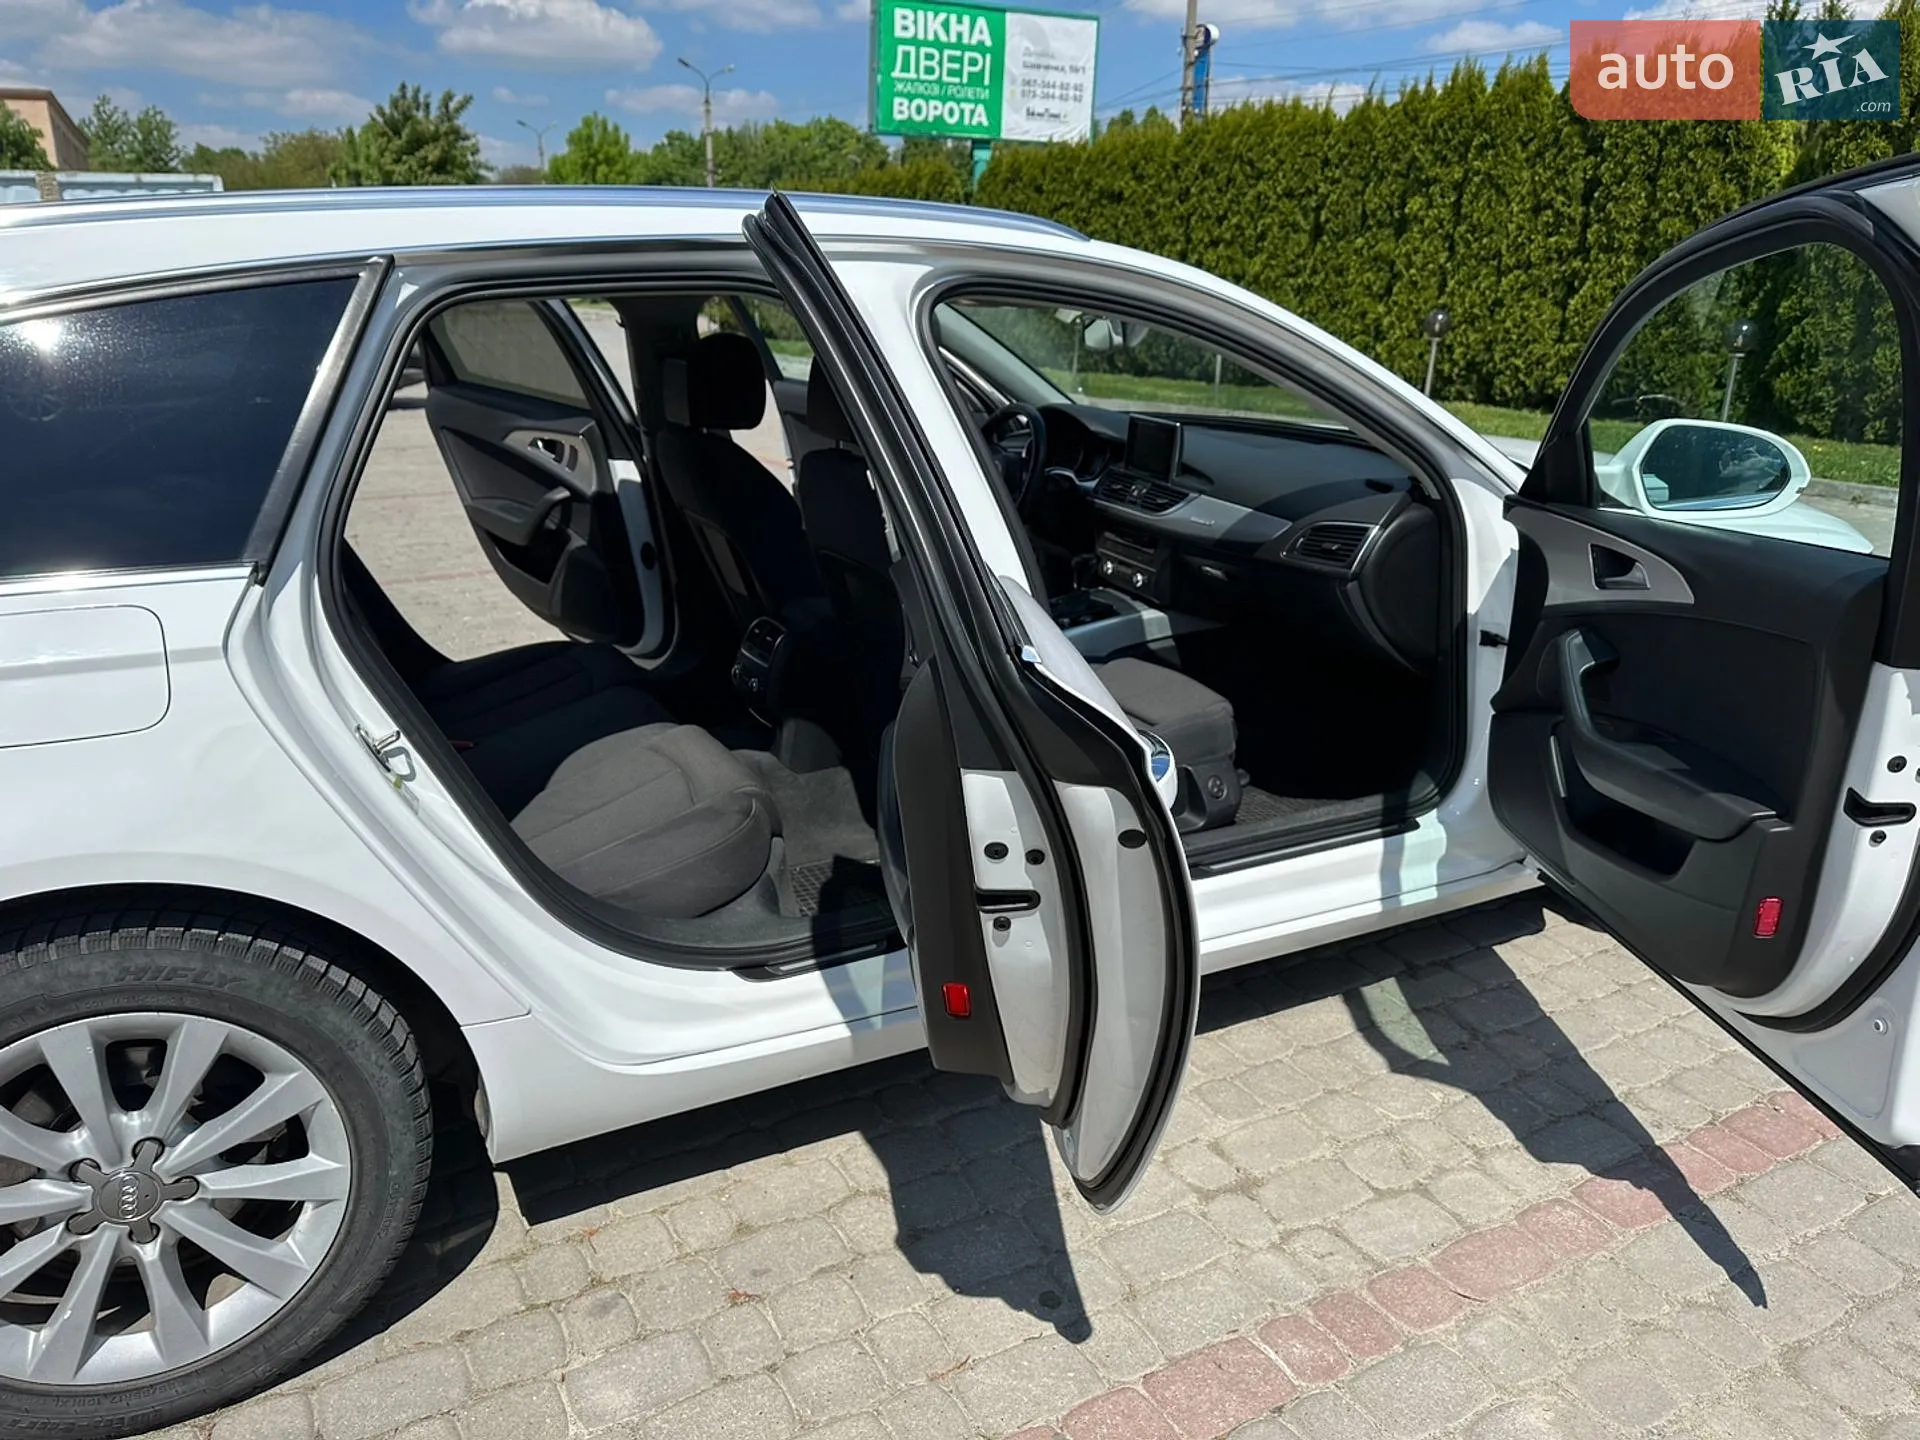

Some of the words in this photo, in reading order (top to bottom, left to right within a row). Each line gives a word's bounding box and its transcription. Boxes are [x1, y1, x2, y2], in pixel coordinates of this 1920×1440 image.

[893, 8, 993, 47] ВІКНА
[890, 45, 991, 85] ДВЕРІ
[893, 97, 989, 126] ВОРОТА
[113, 964, 246, 991] HIFLY
